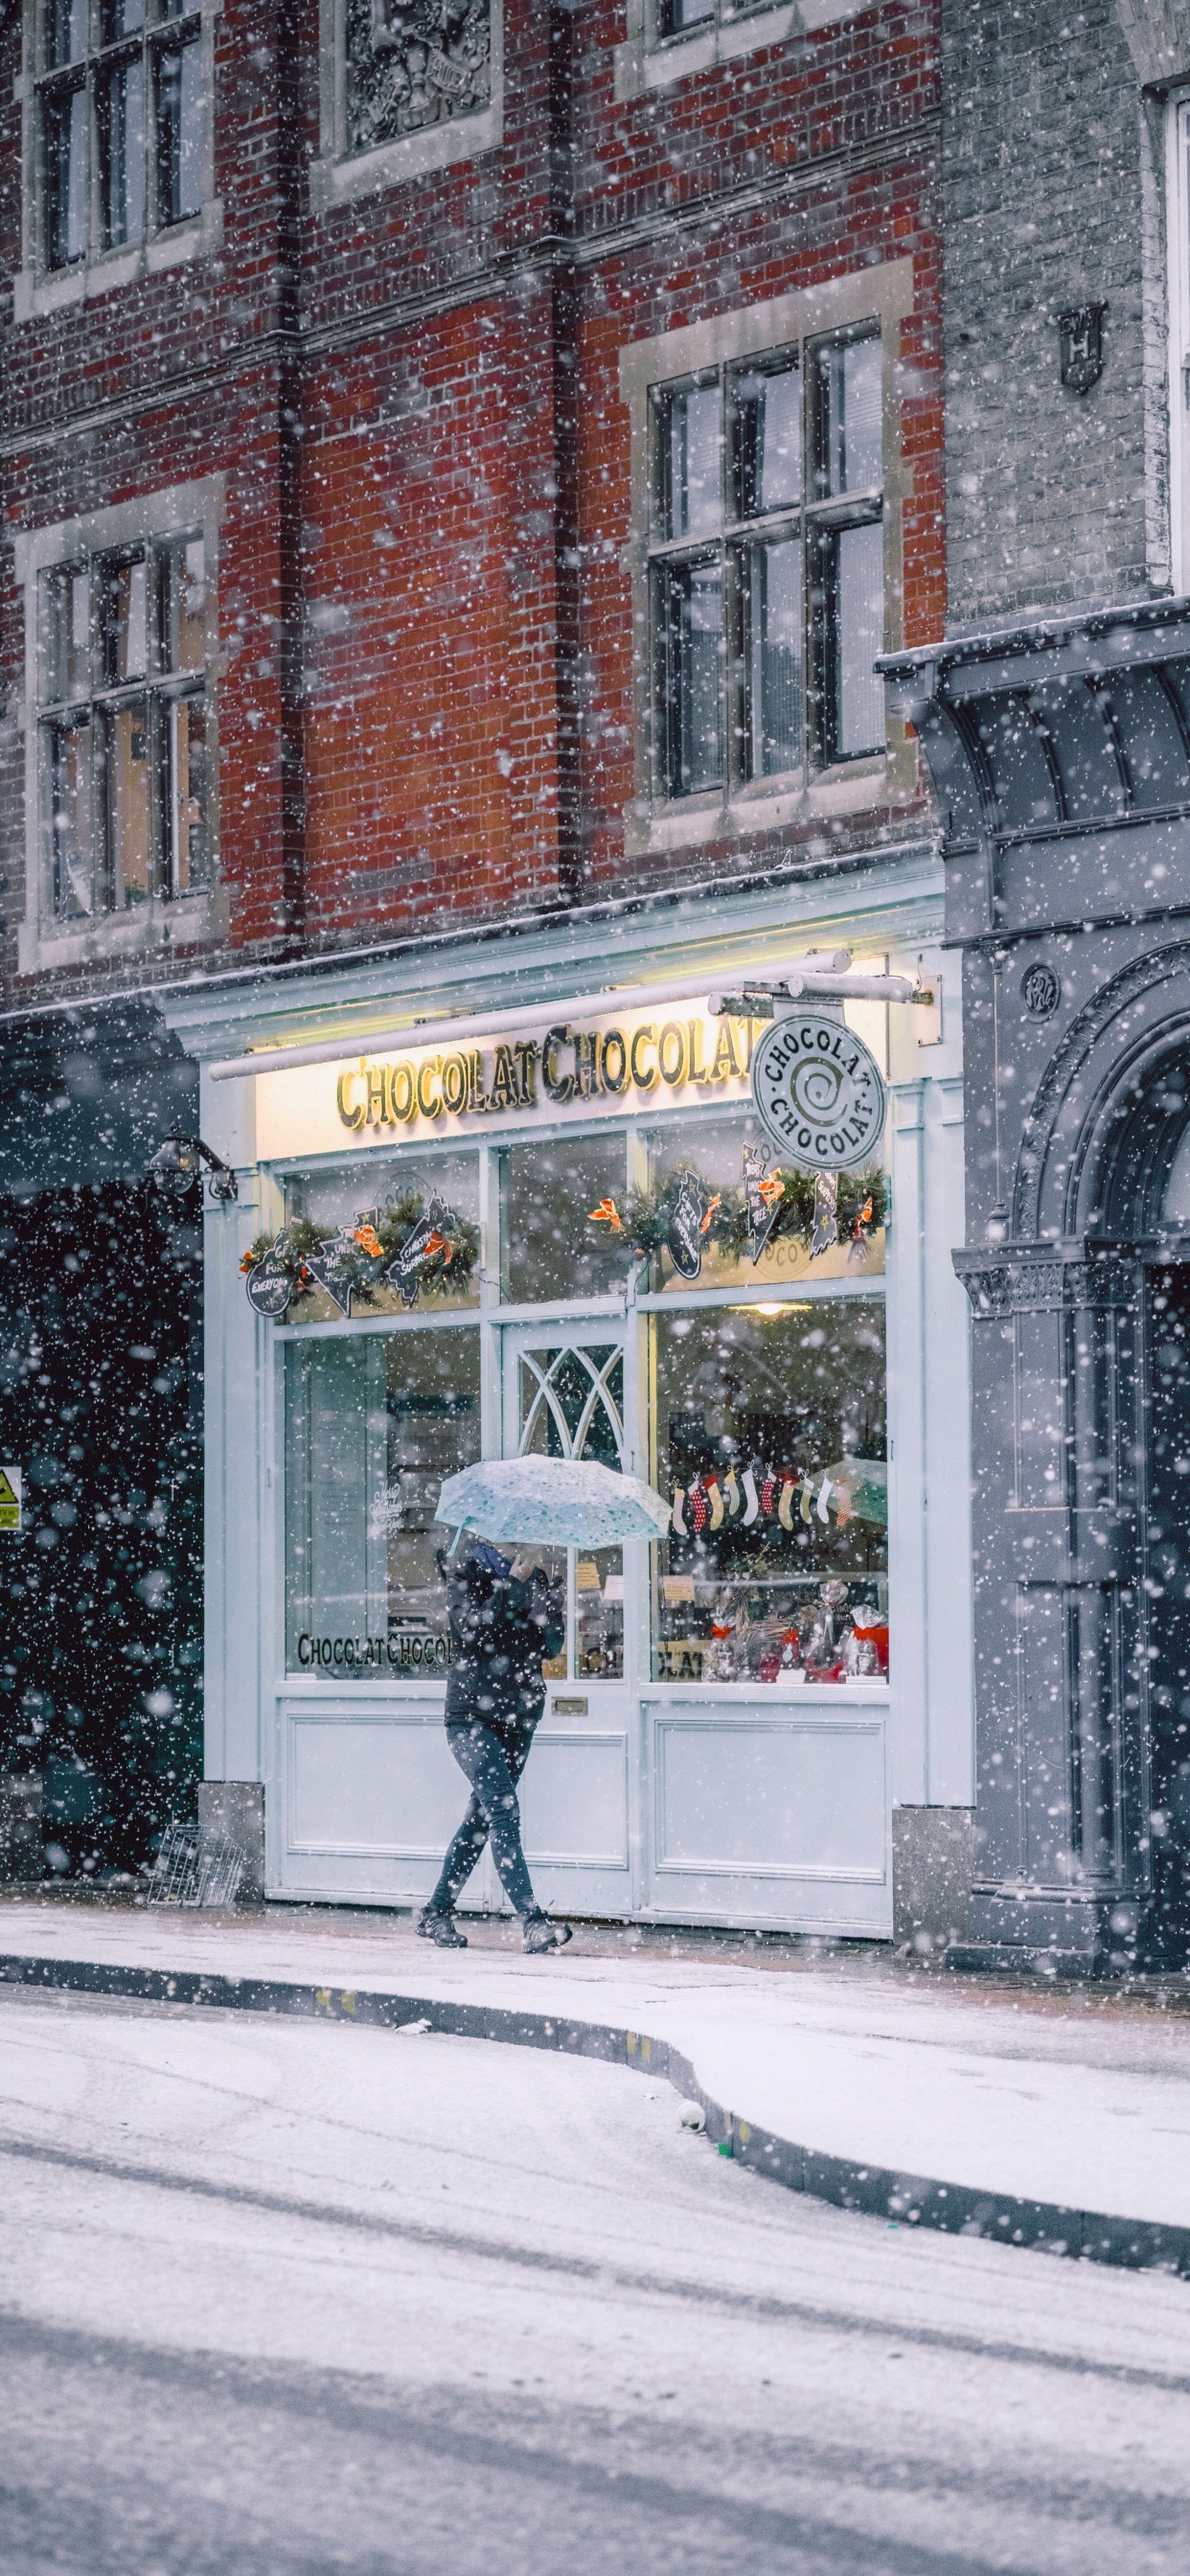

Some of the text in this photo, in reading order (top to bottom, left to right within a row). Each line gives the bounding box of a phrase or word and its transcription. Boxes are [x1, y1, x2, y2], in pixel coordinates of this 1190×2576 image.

[337, 1038, 540, 1131] CHOCOLAT
[765, 1027, 872, 1088] CHOCOLAT
[770, 1098, 873, 1156] CHOCOLAT
[324, 1256, 342, 1270] THE
[298, 1633, 455, 1666] CHOCOLAT CHOCOL
